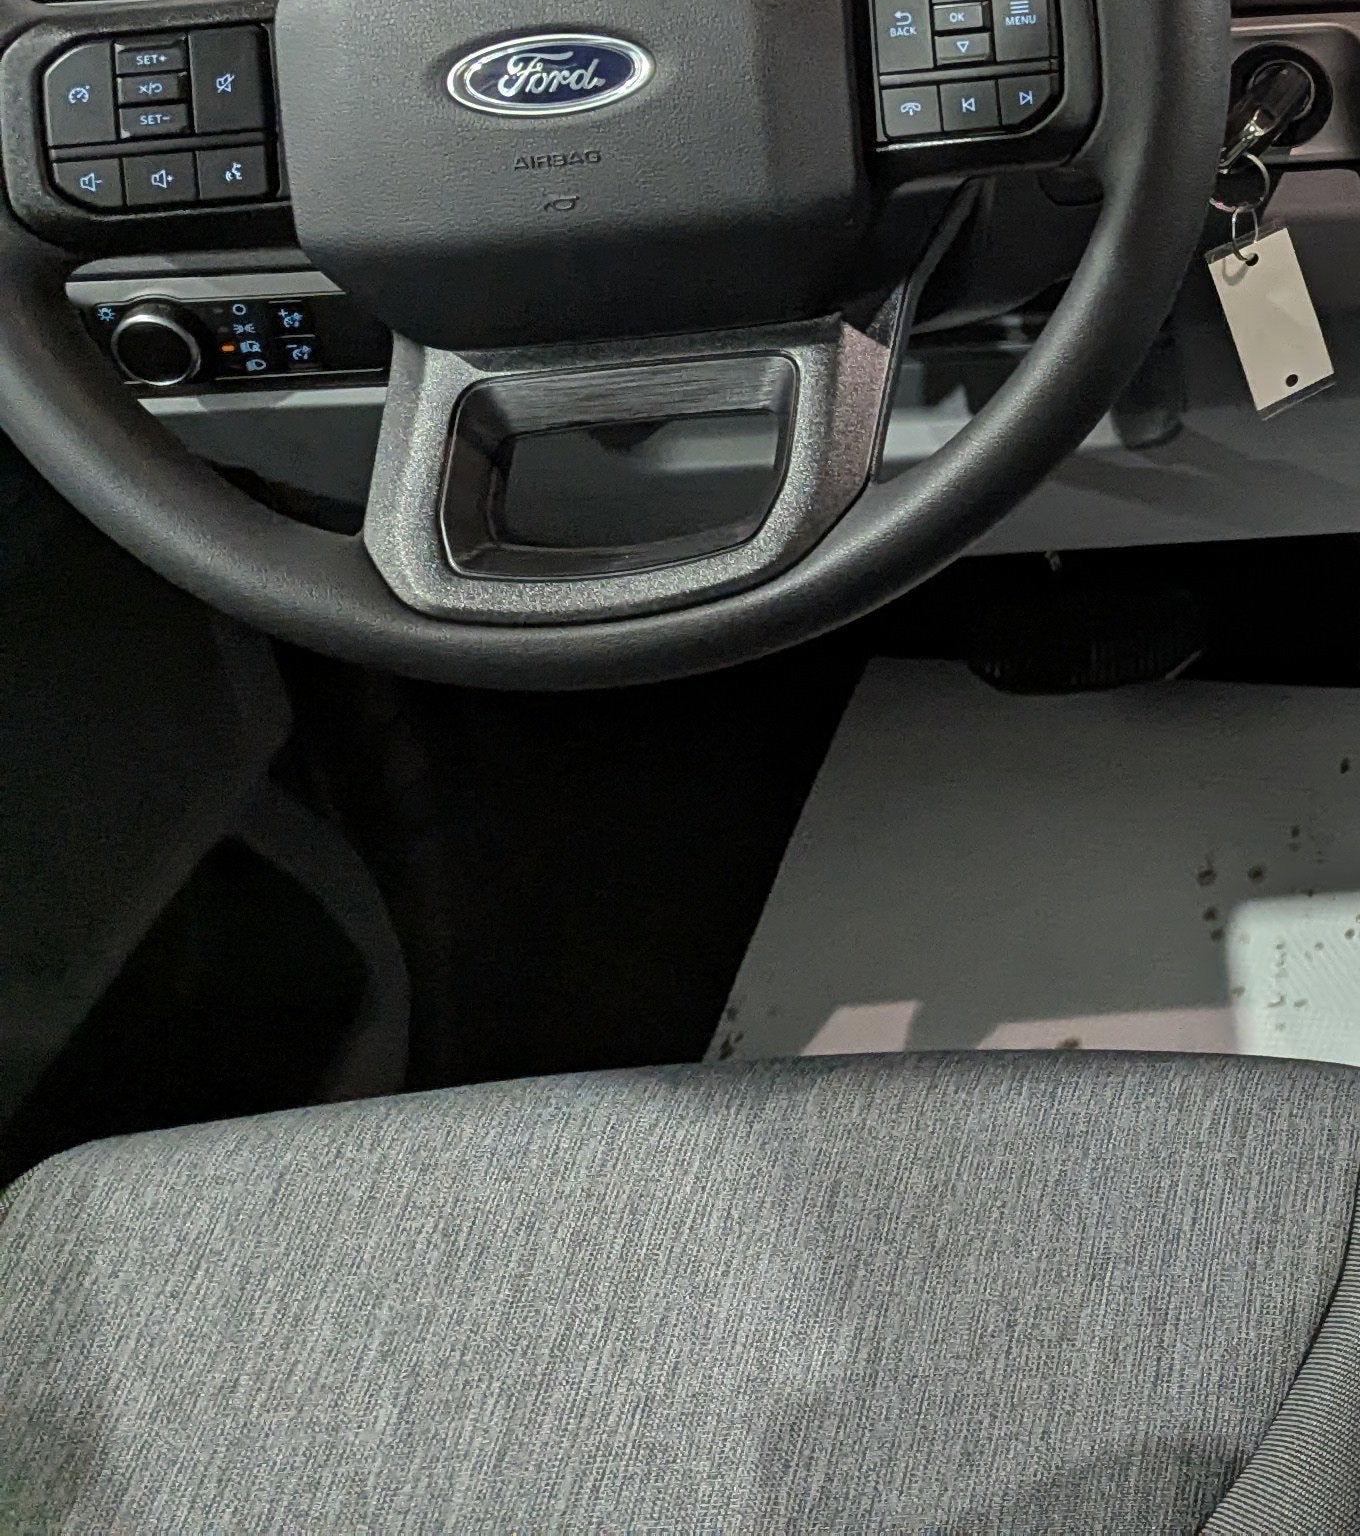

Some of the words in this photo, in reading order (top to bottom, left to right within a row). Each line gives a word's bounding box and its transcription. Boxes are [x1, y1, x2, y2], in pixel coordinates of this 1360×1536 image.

[949, 11, 965, 23] OK
[1004, 15, 1037, 27] MENU
[889, 25, 918, 38] BACK
[497, 50, 607, 97] Ford
[513, 149, 602, 171] AIRBAG
